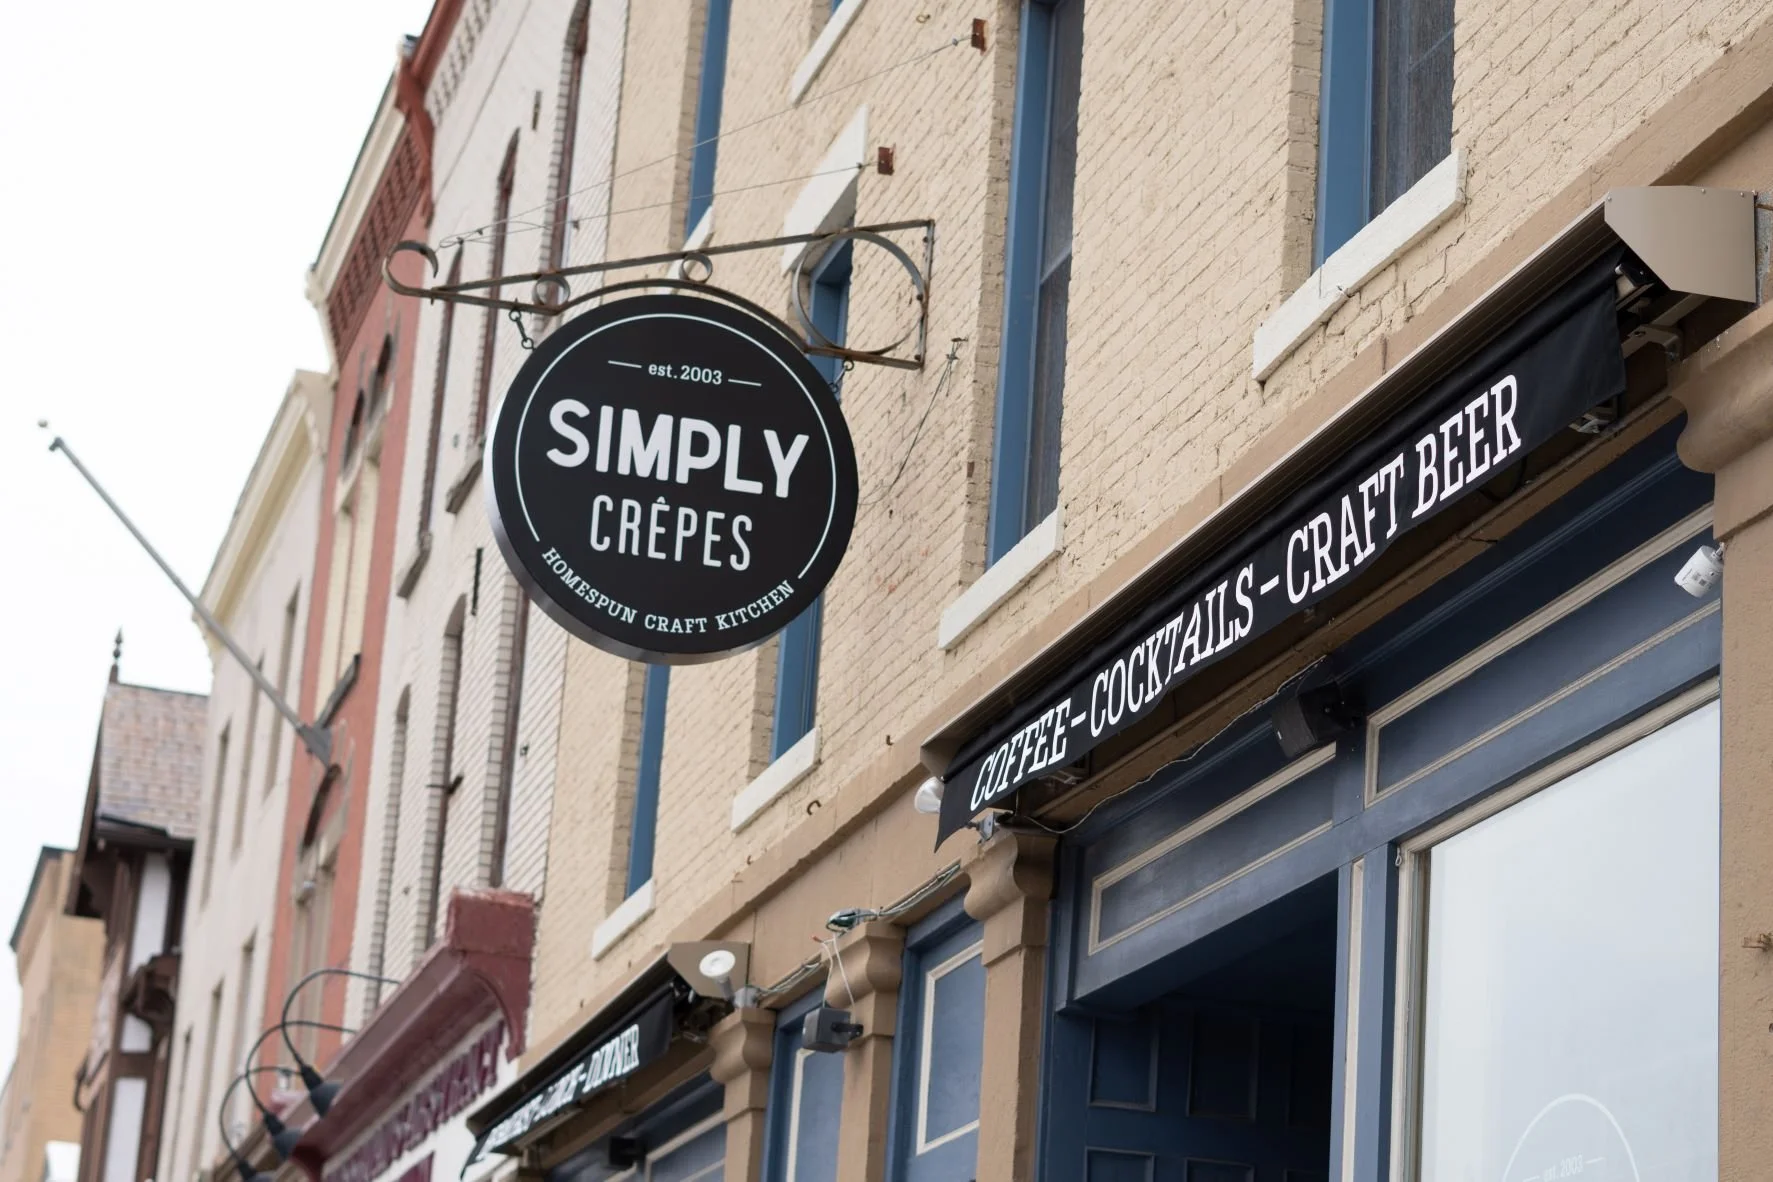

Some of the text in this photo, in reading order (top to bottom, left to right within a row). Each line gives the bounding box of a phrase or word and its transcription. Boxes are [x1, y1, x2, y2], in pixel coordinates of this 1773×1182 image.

[546, 398, 810, 499] SIMPLY
[1411, 373, 1522, 519] BEER
[589, 494, 753, 571] CRÊPES
[541, 547, 796, 634] HOMESPUN CRAFT KITCHEN
